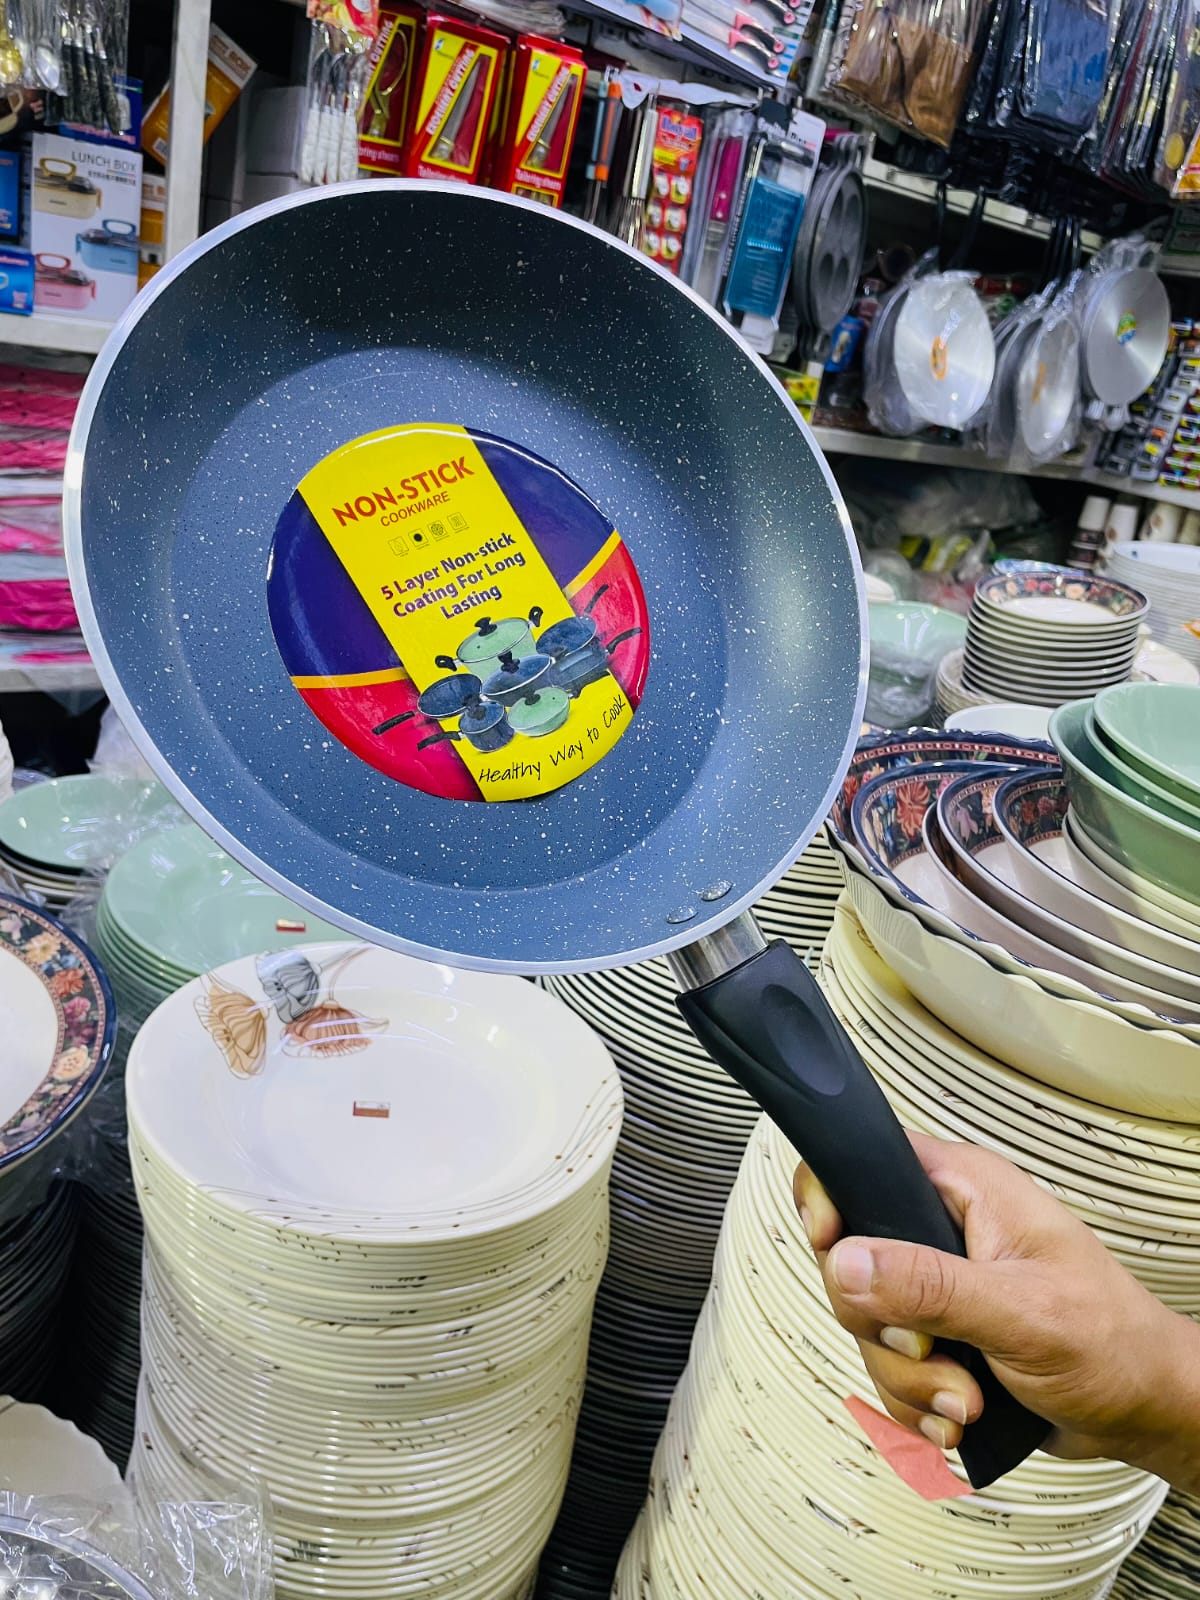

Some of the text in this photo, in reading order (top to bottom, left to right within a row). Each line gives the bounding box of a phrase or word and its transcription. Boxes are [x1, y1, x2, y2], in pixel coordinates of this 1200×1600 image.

[449, 48, 475, 90] CUTTING
[71, 151, 136, 172] LUNCH BOX
[332, 456, 475, 527] NON-STICK
[380, 491, 451, 527] COOKWARE
[380, 532, 517, 600] 5 Layer Non-stick
[393, 551, 527, 618] Coating For Long
[439, 585, 503, 620] Lasting
[478, 694, 627, 783] Healthy Way to Cook
